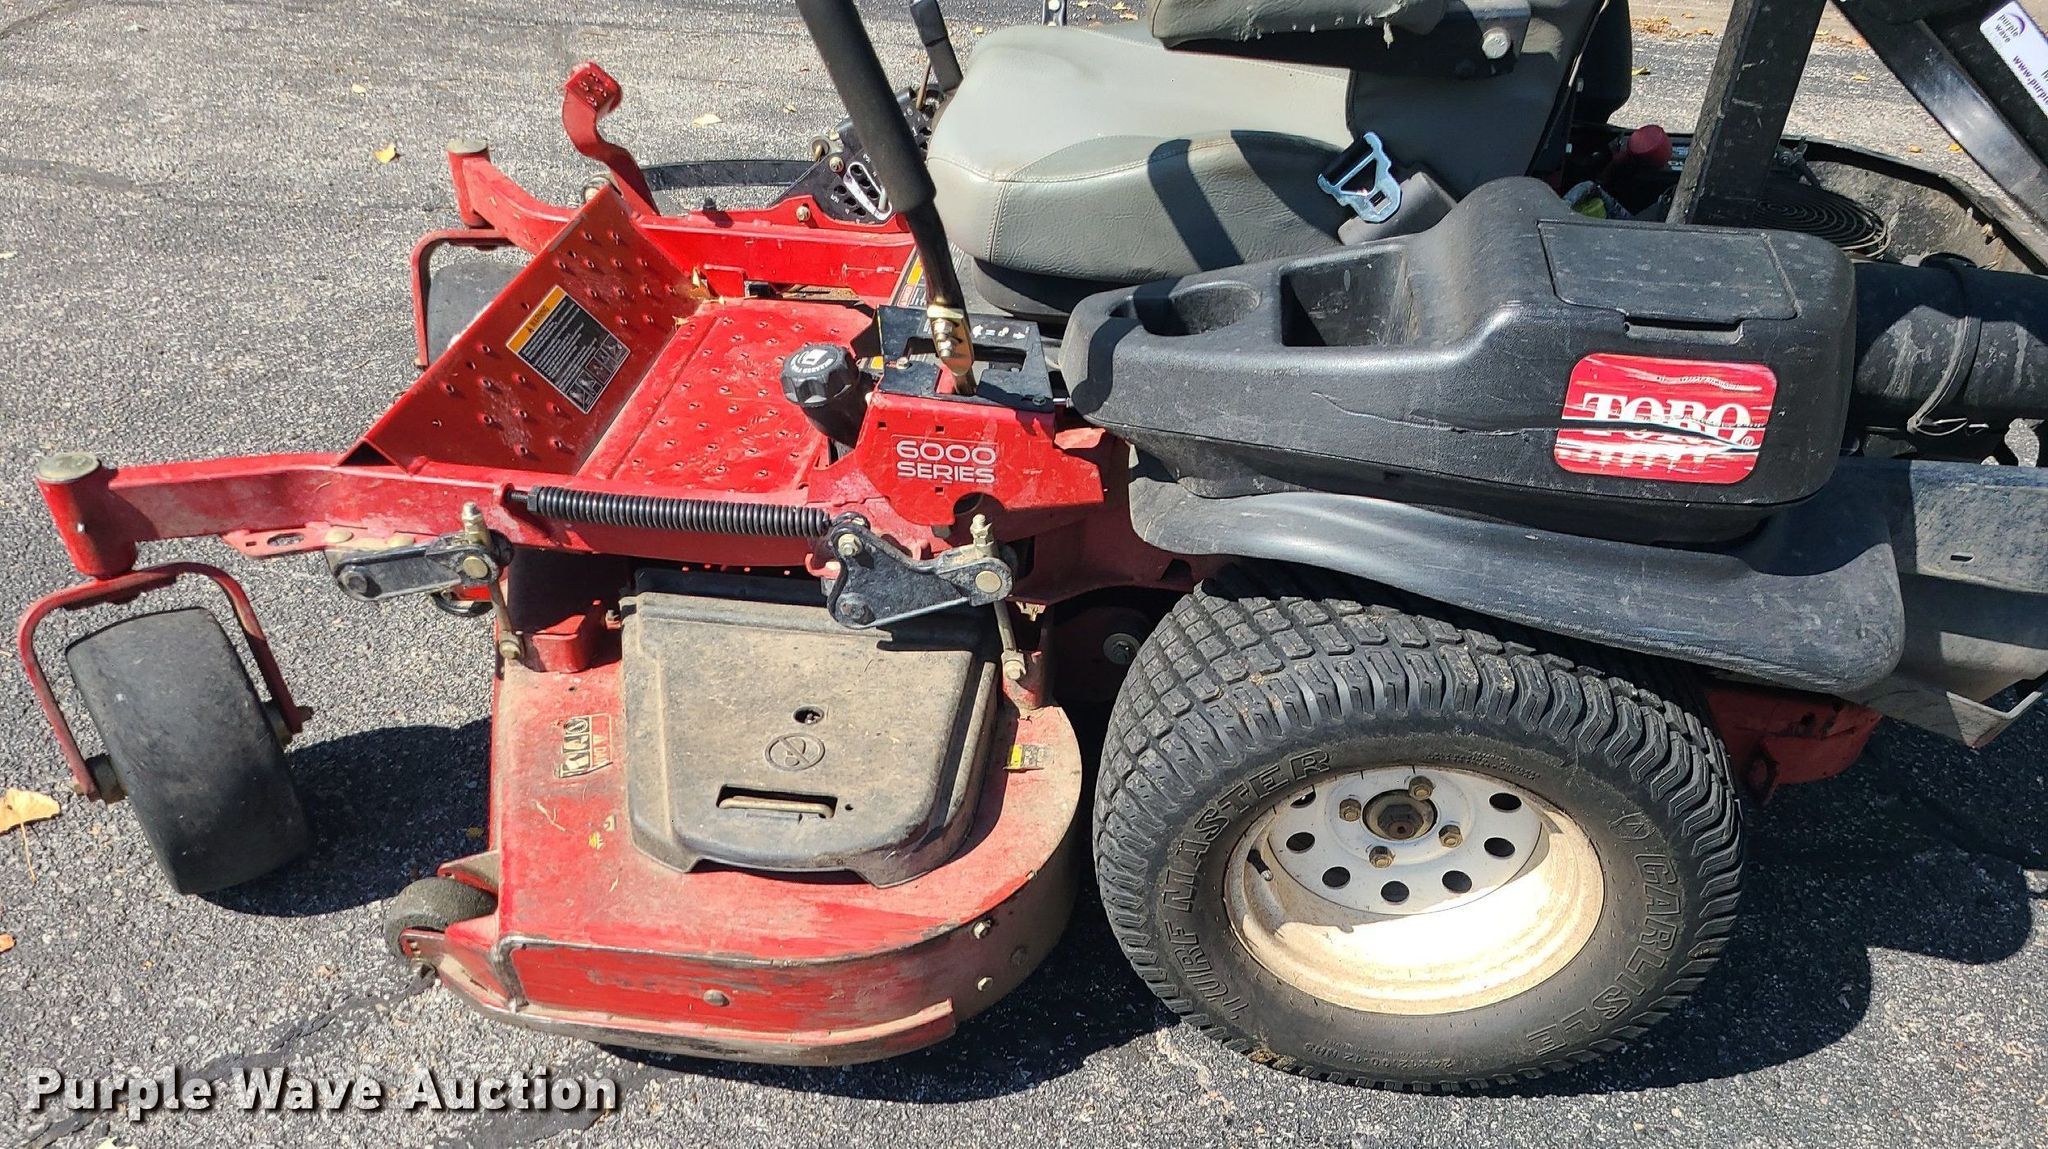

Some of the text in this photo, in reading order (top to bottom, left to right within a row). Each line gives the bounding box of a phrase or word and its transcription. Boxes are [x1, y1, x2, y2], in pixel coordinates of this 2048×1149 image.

[1994, 24, 2010, 43] wave
[1998, 14, 2019, 37] purple
[1582, 392, 1752, 446] TORO
[896, 440, 996, 465] 6000
[896, 461, 996, 484] SERIES
[1161, 749, 1332, 1021] TURF MASTER
[1526, 853, 1682, 1057] CARLISLE
